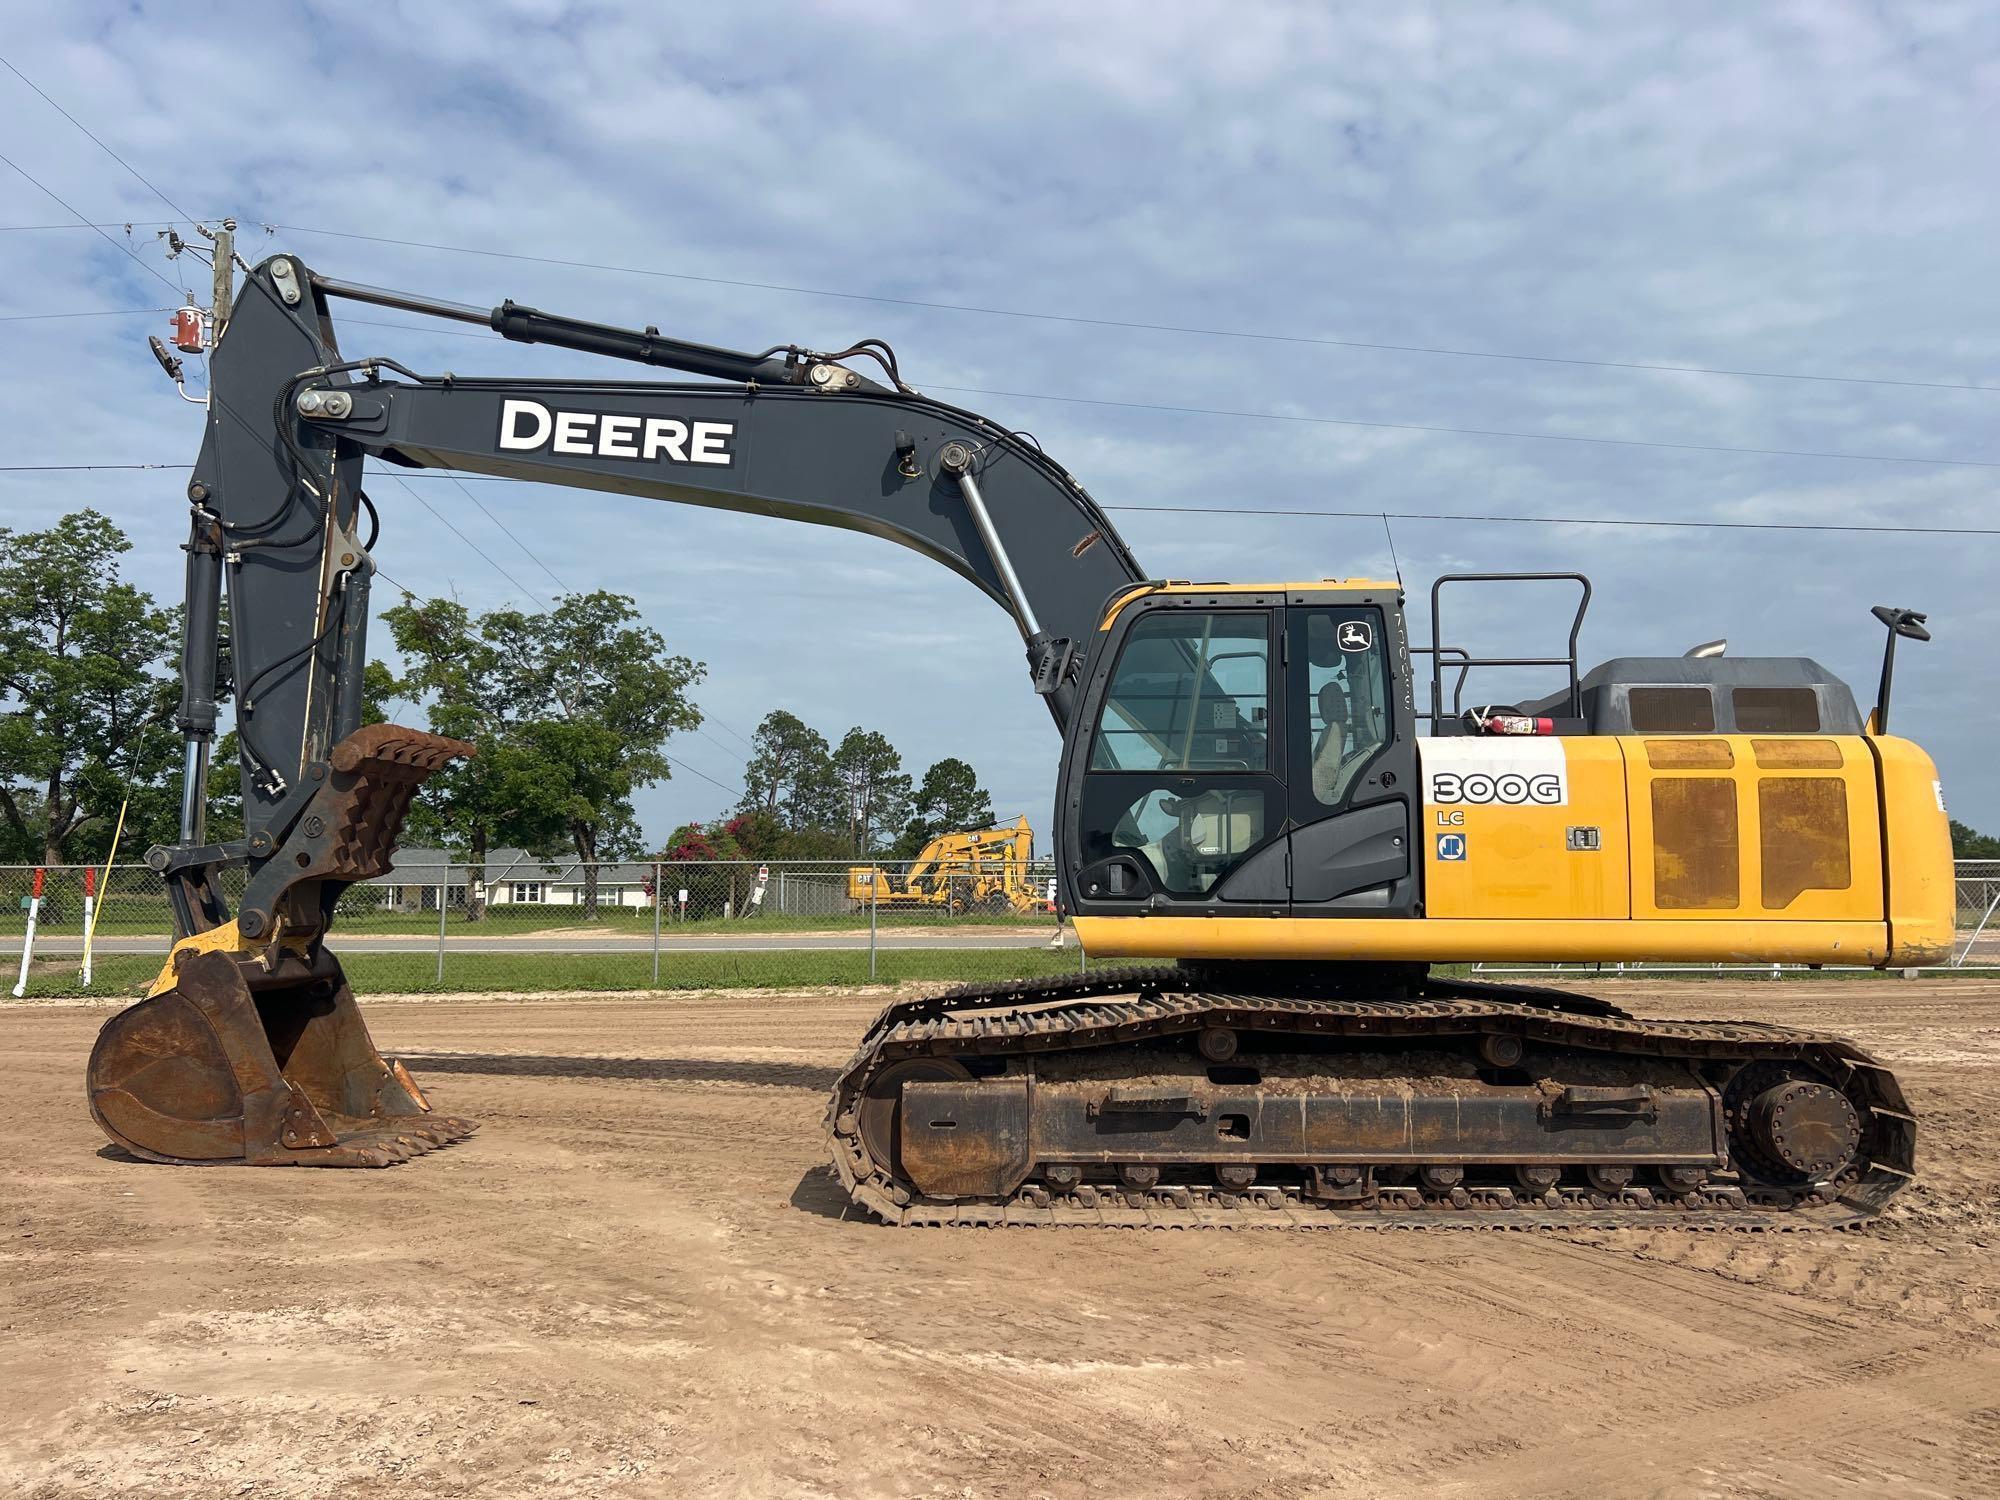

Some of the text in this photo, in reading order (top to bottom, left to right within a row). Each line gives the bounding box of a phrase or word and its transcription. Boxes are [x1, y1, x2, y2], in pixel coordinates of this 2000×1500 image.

[499, 399, 734, 465] DEERE
[1433, 773, 1561, 804] 300G
[1437, 811, 1464, 826] LC
